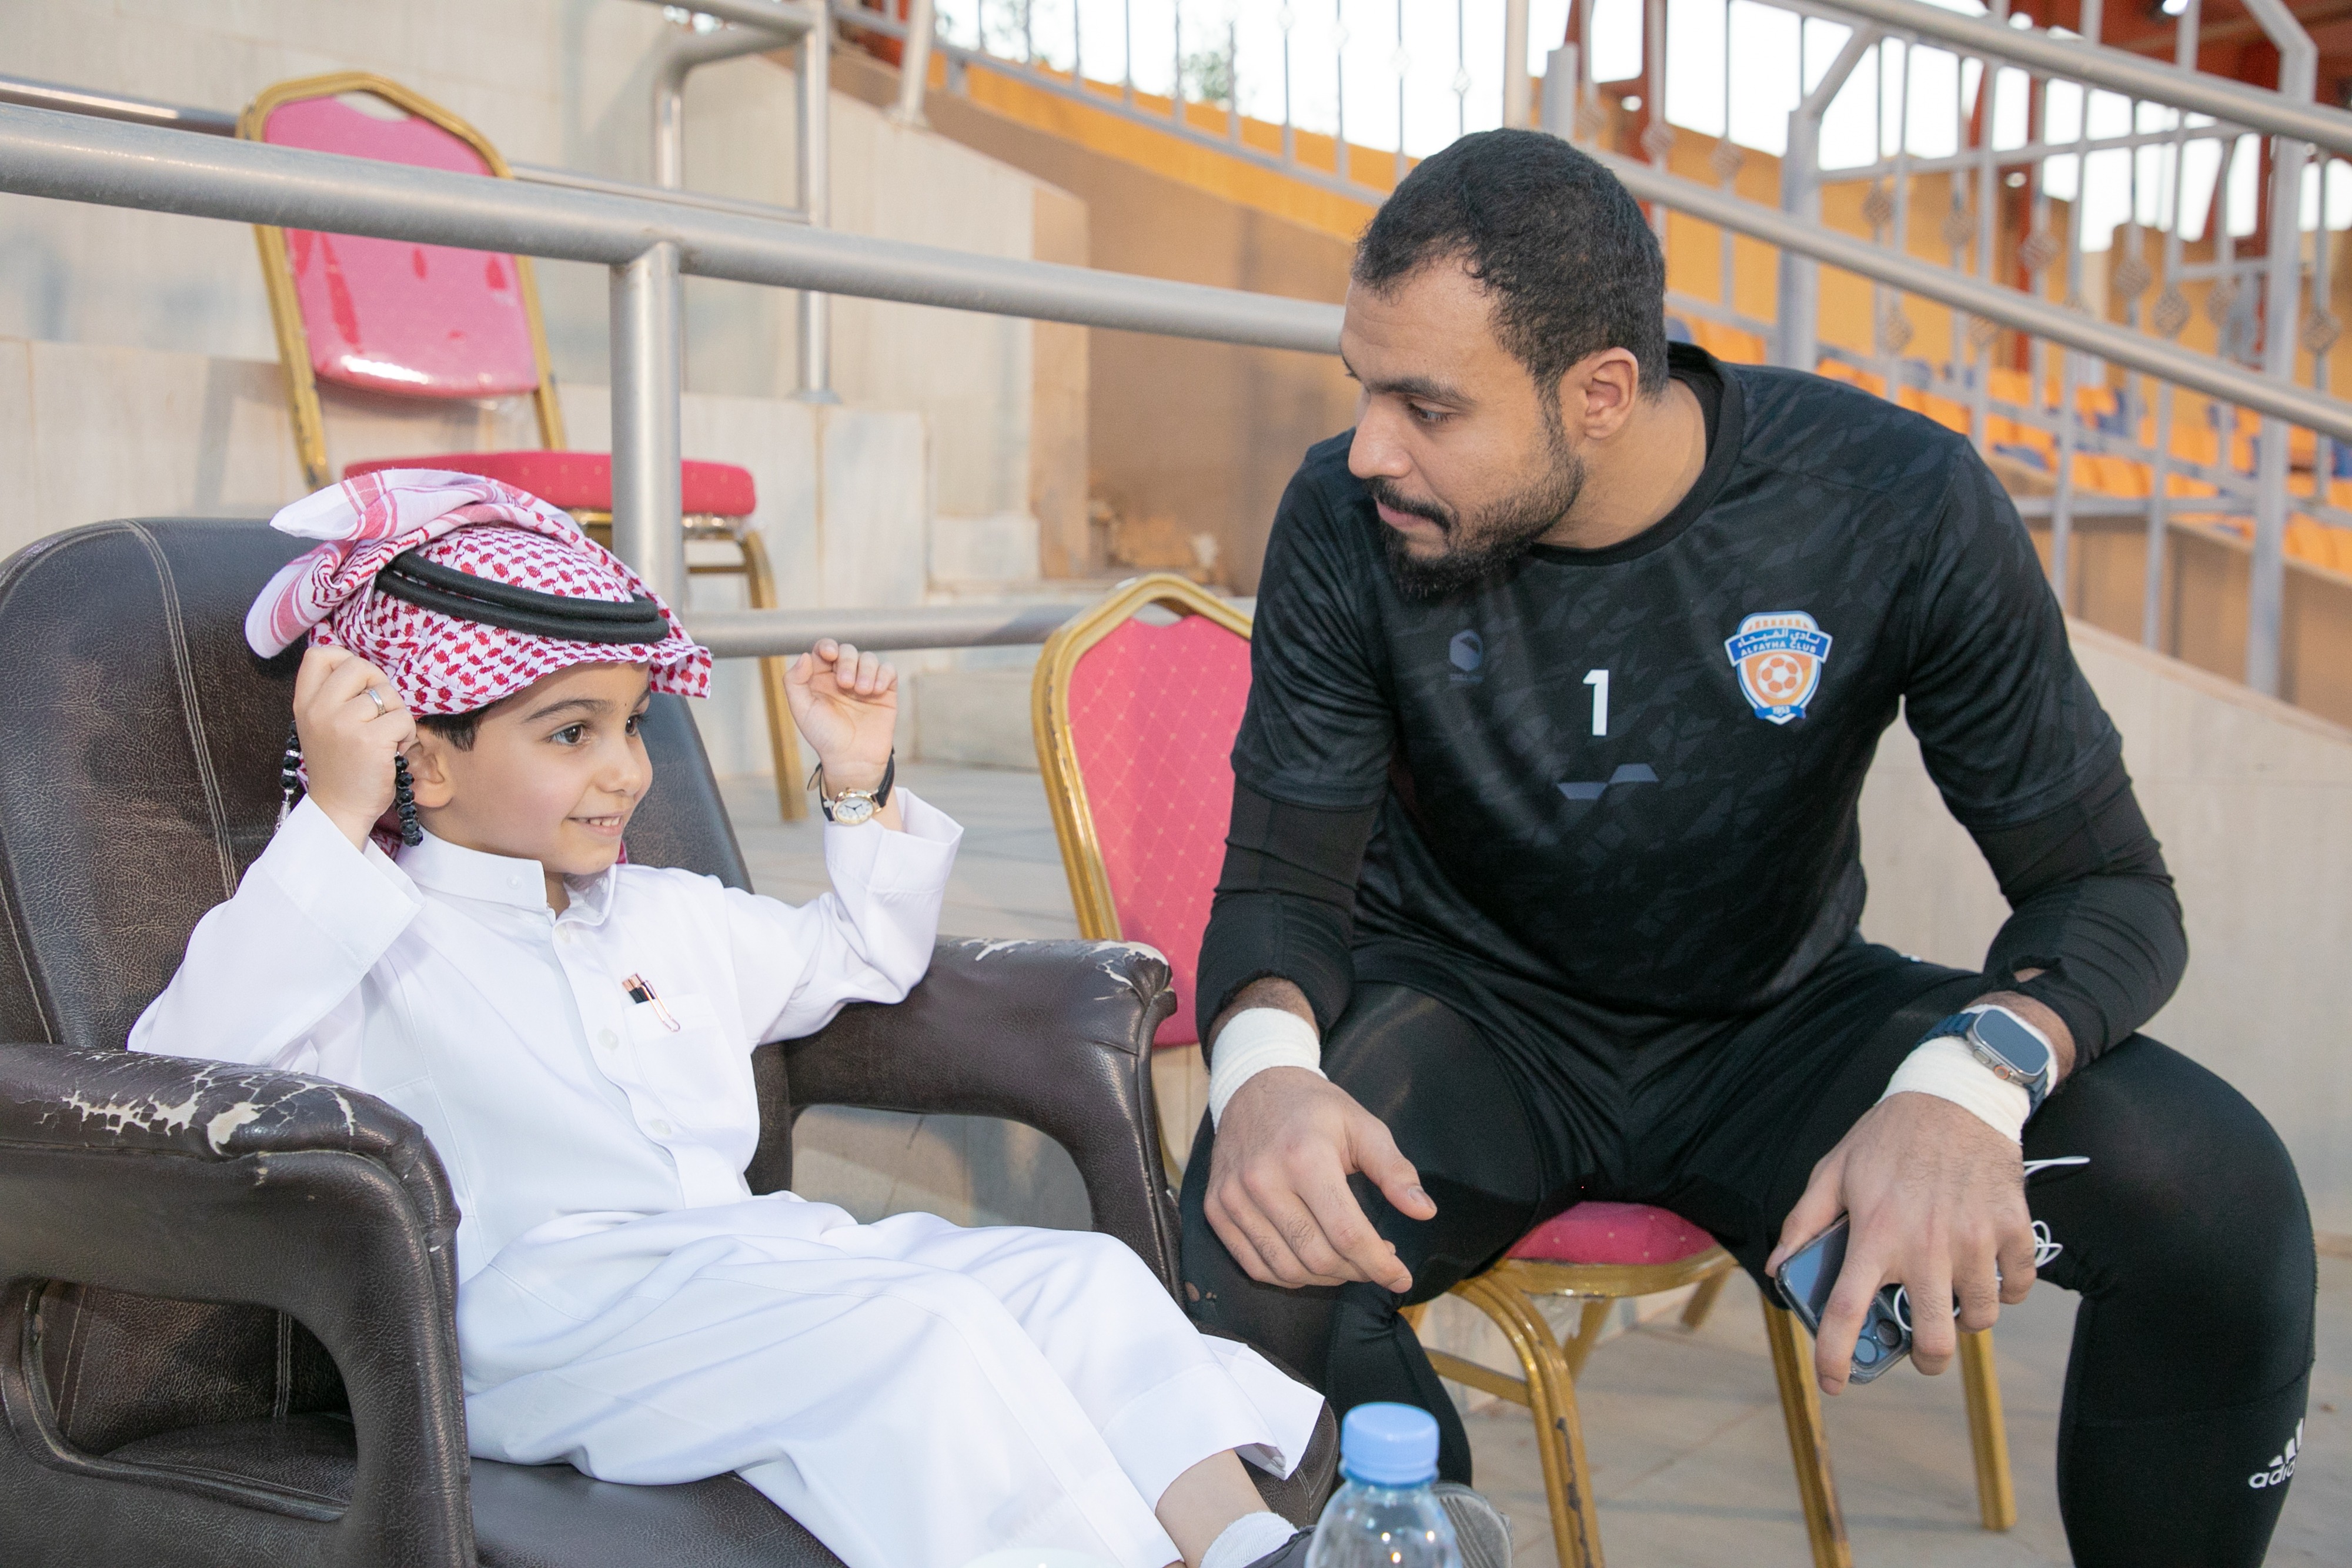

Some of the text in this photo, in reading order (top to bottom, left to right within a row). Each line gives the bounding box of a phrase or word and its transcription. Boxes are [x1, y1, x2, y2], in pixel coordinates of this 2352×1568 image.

[1740, 640, 1816, 657] ALFAYHA CLUB
[1790, 631, 1820, 644] نادي
[1582, 670, 1609, 736] 1
[2249, 1459, 2296, 1488] adid
